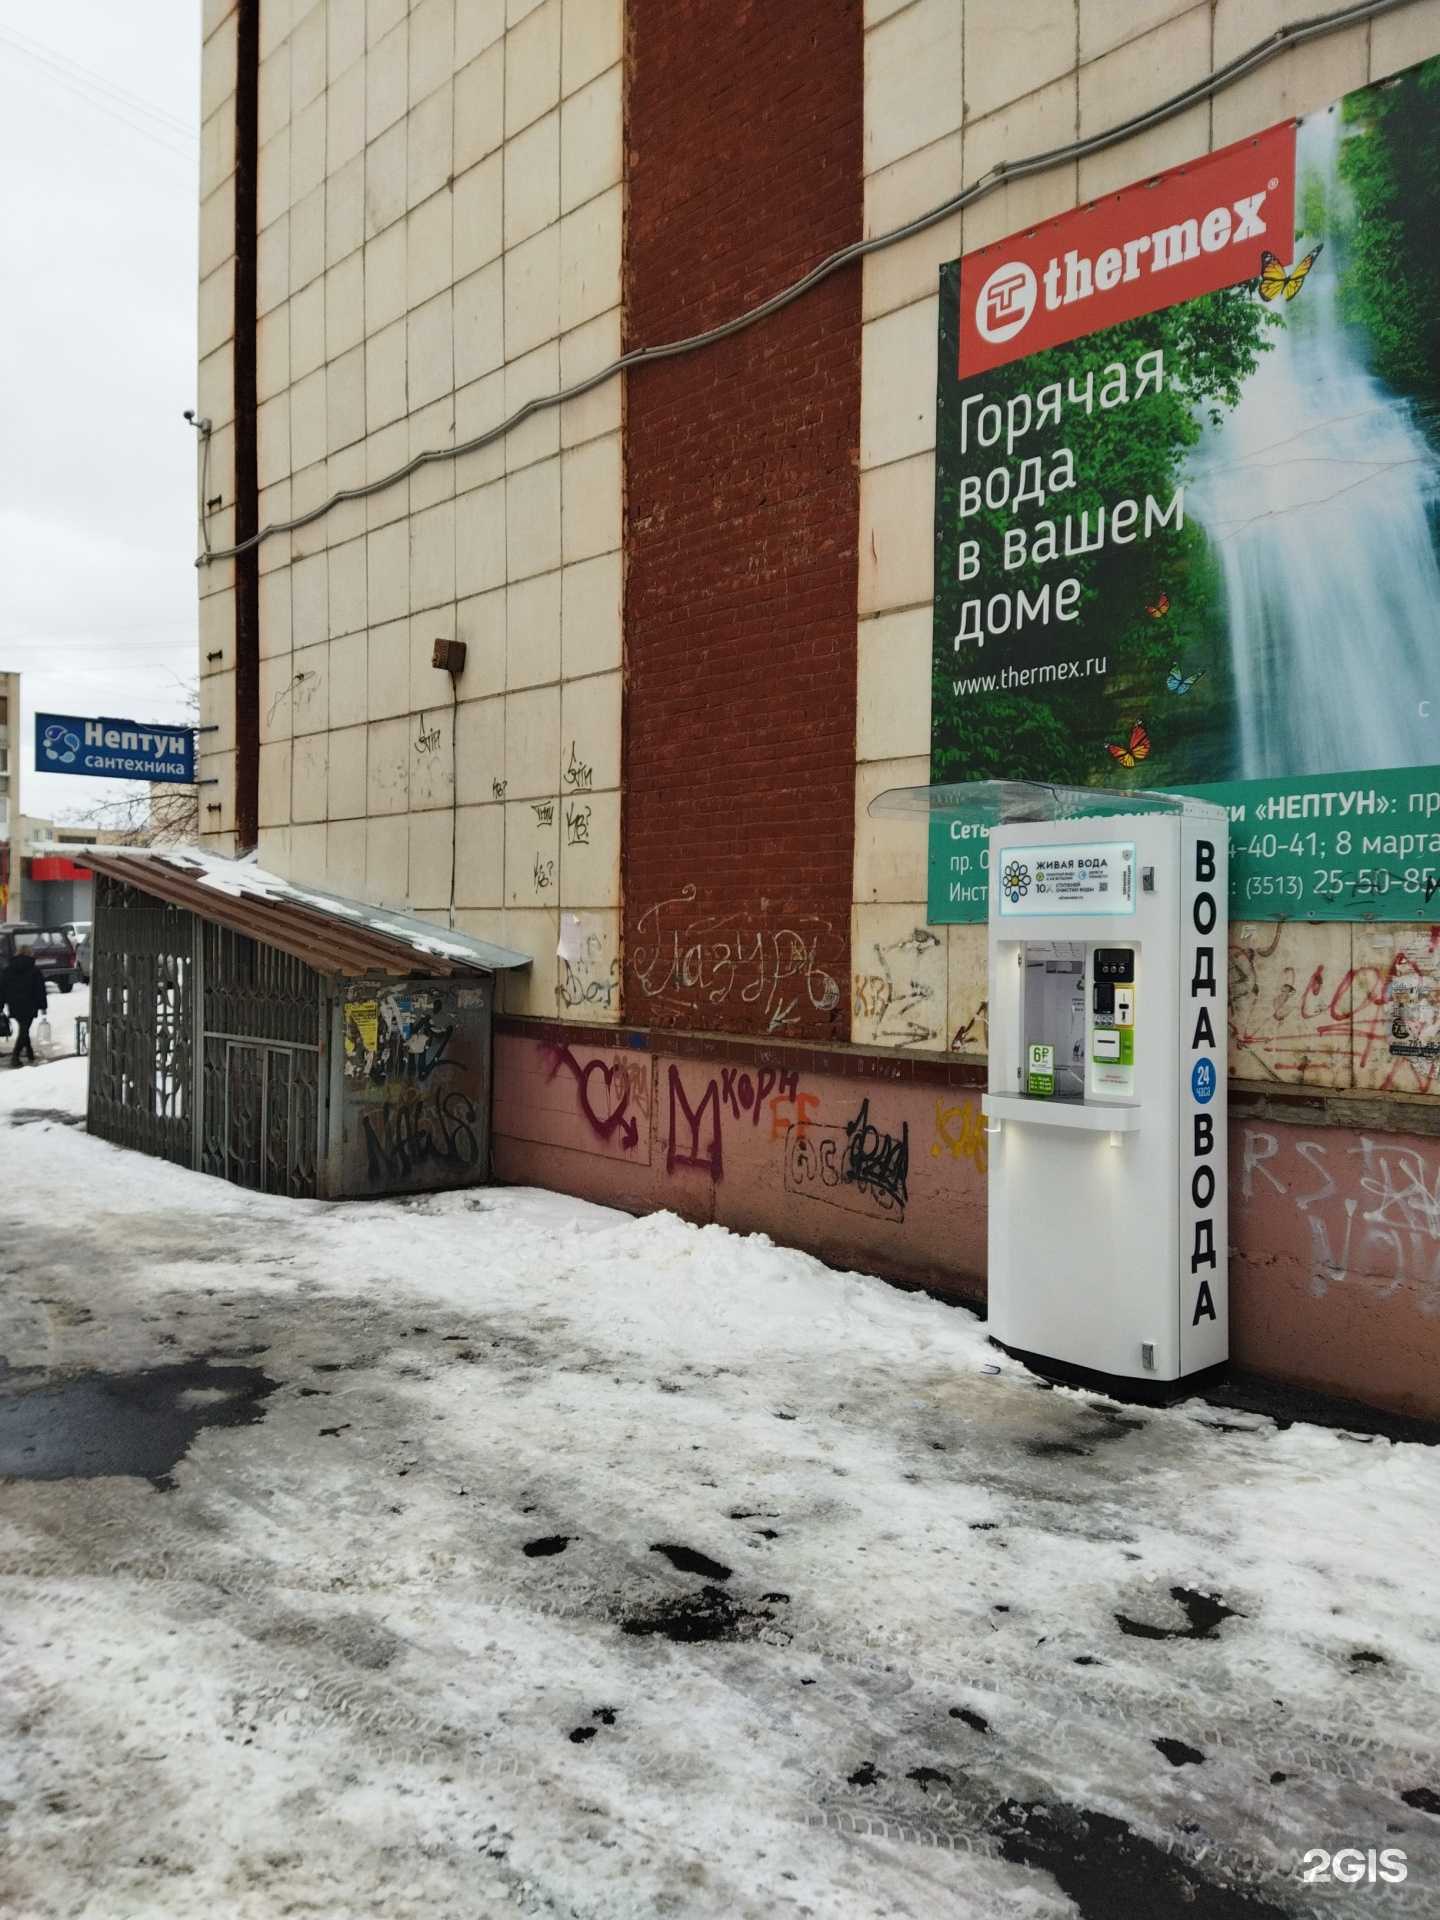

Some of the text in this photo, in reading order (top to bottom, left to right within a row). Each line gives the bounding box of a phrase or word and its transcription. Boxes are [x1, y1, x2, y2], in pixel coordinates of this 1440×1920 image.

[1043, 191, 1267, 312] thermex
[961, 349, 1164, 455] Горячая
[960, 448, 1076, 518] вода
[958, 486, 1185, 581] в вашем
[954, 578, 1081, 652] доме
[953, 657, 1107, 697] www.thermex.ru
[84, 721, 186, 758] Нептун
[84, 754, 186, 775] сантехника
[950, 820, 990, 840] Сеть
[1255, 790, 1397, 821] «НЕПТУН»:
[950, 855, 973, 876] пр.
[1335, 830, 1352, 855] 8
[1362, 833, 1440, 860] марта
[1036, 858, 1109, 870] ЖИВАЯ ВОДА
[1246, 876, 1303, 900] (3513)
[1191, 839, 1217, 1050] ВОДА
[1197, 1065, 1210, 1086] 24
[1191, 1112, 1217, 1326] ВОДА
